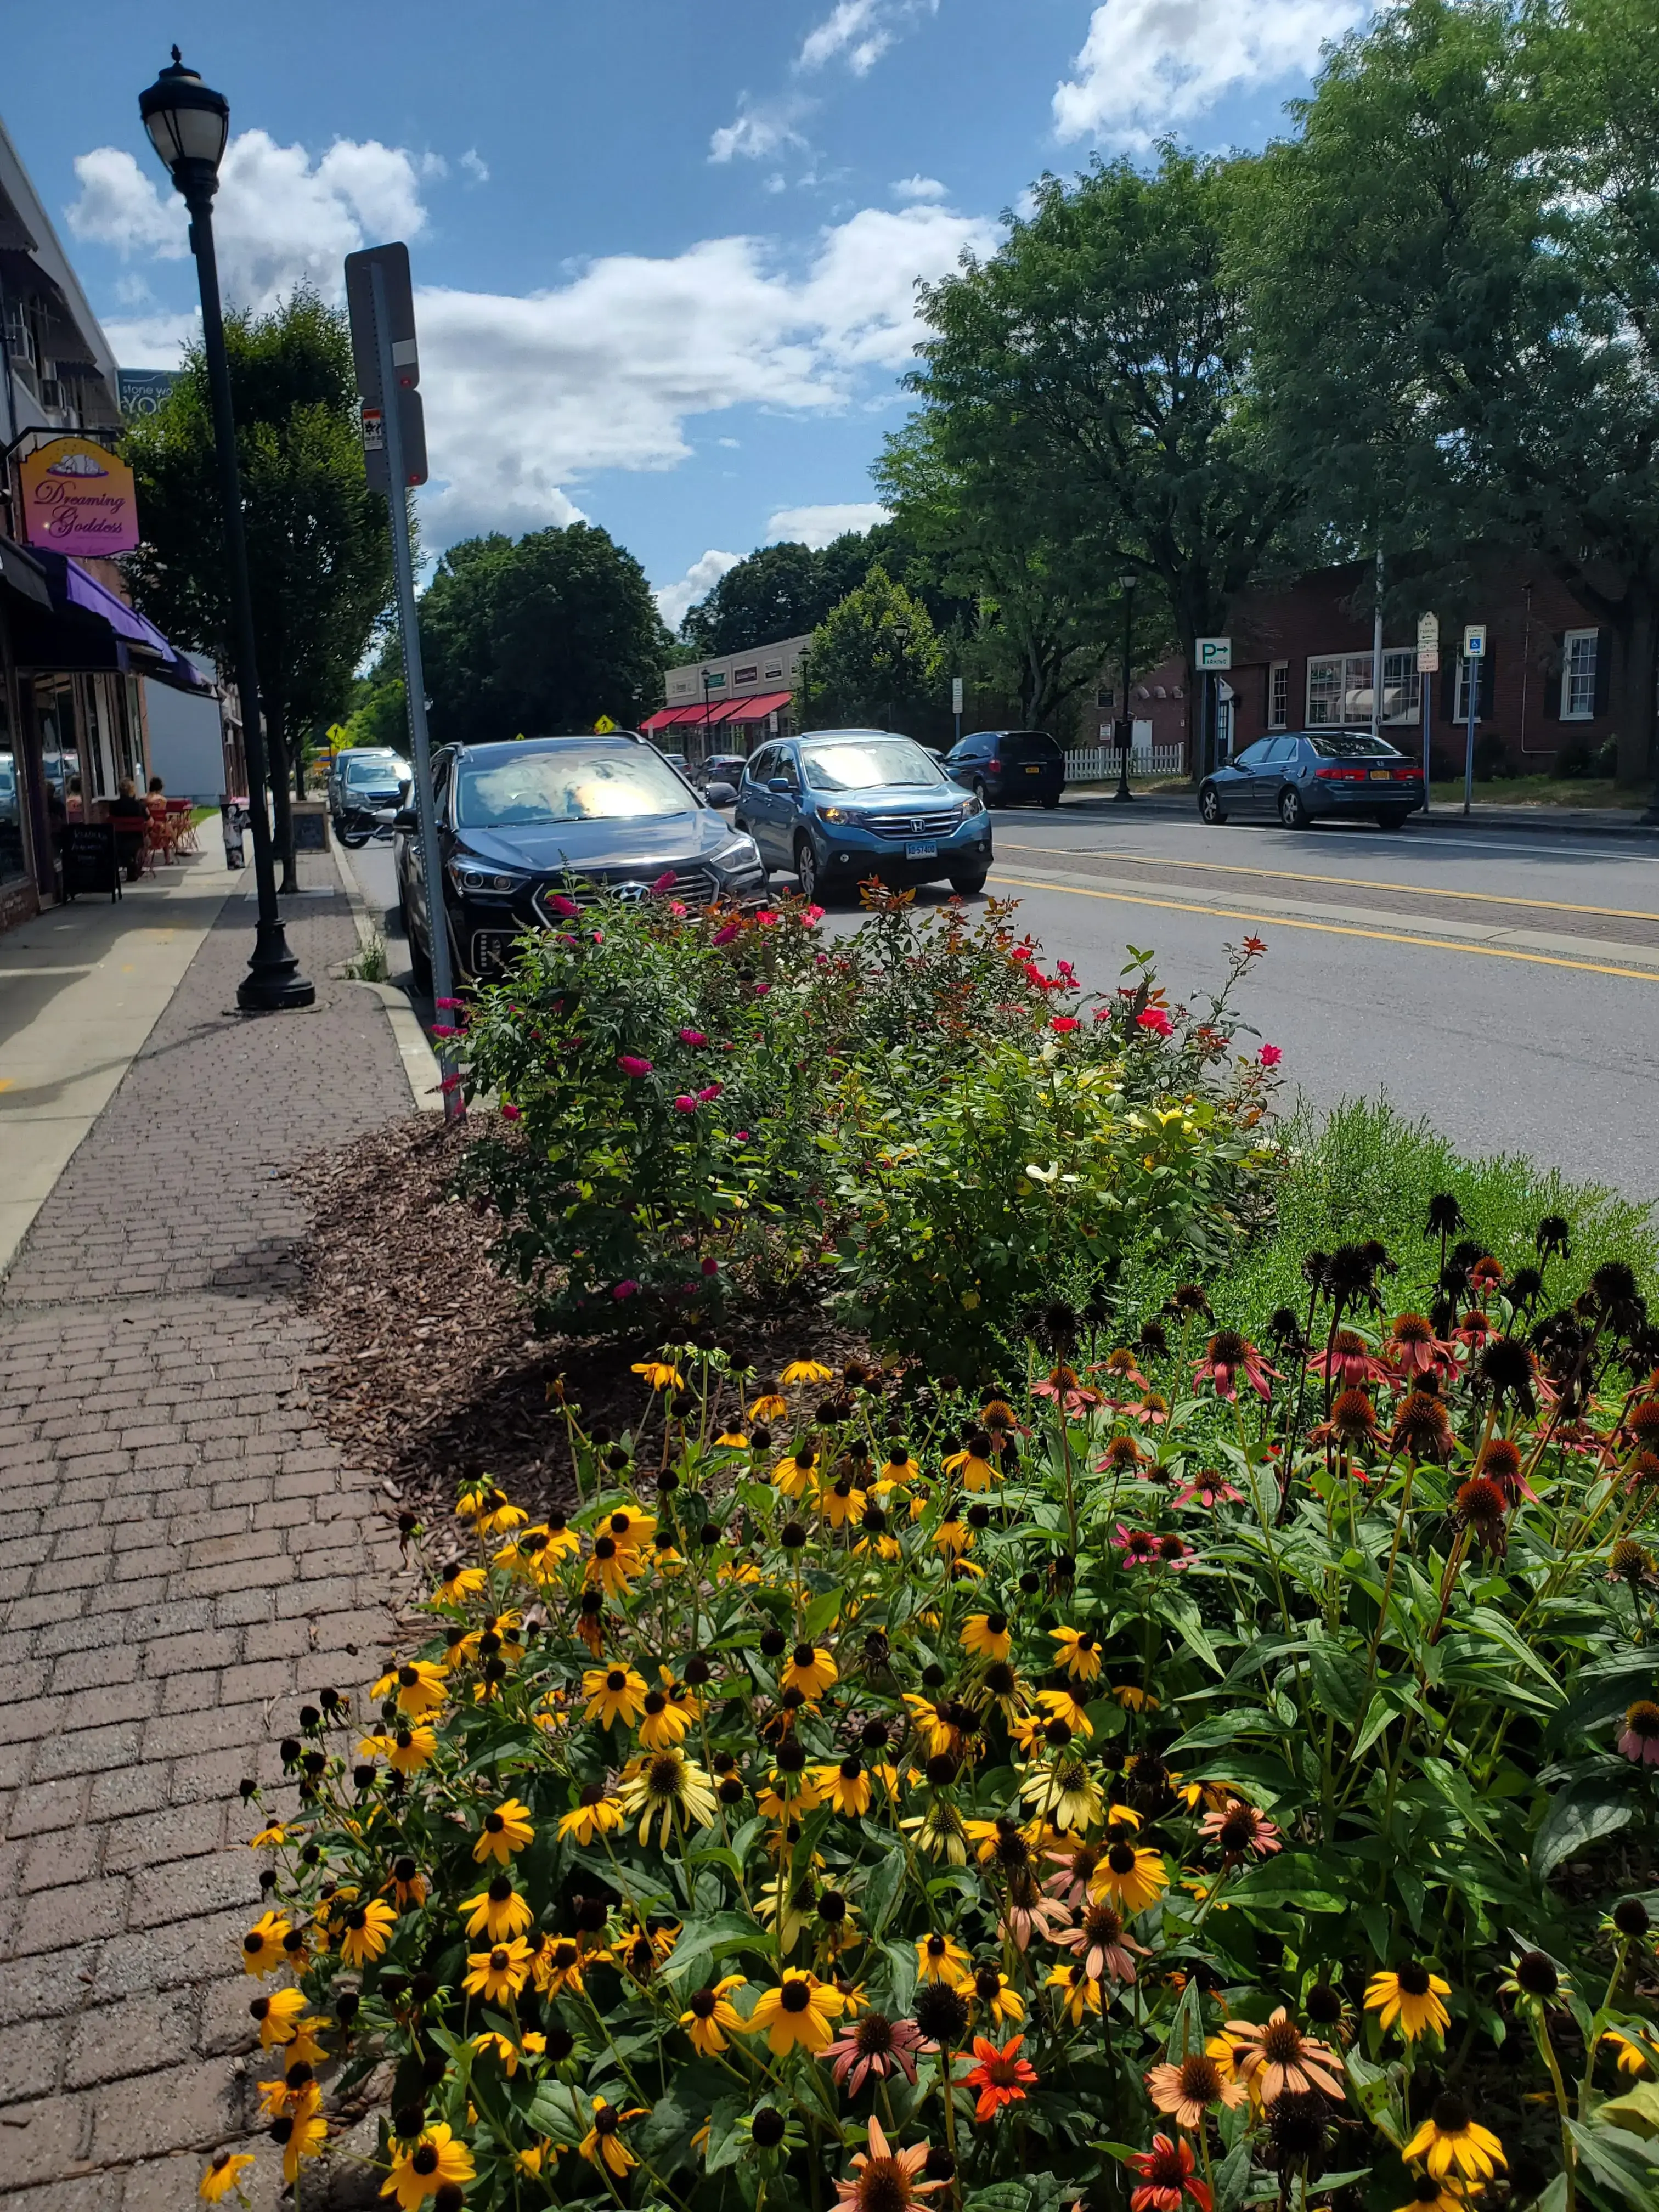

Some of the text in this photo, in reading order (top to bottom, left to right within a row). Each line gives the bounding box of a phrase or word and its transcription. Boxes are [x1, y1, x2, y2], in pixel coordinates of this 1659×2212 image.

[122, 384, 154, 395] stone
[33, 479, 126, 514] Dreaming
[49, 505, 122, 538] Goddess
